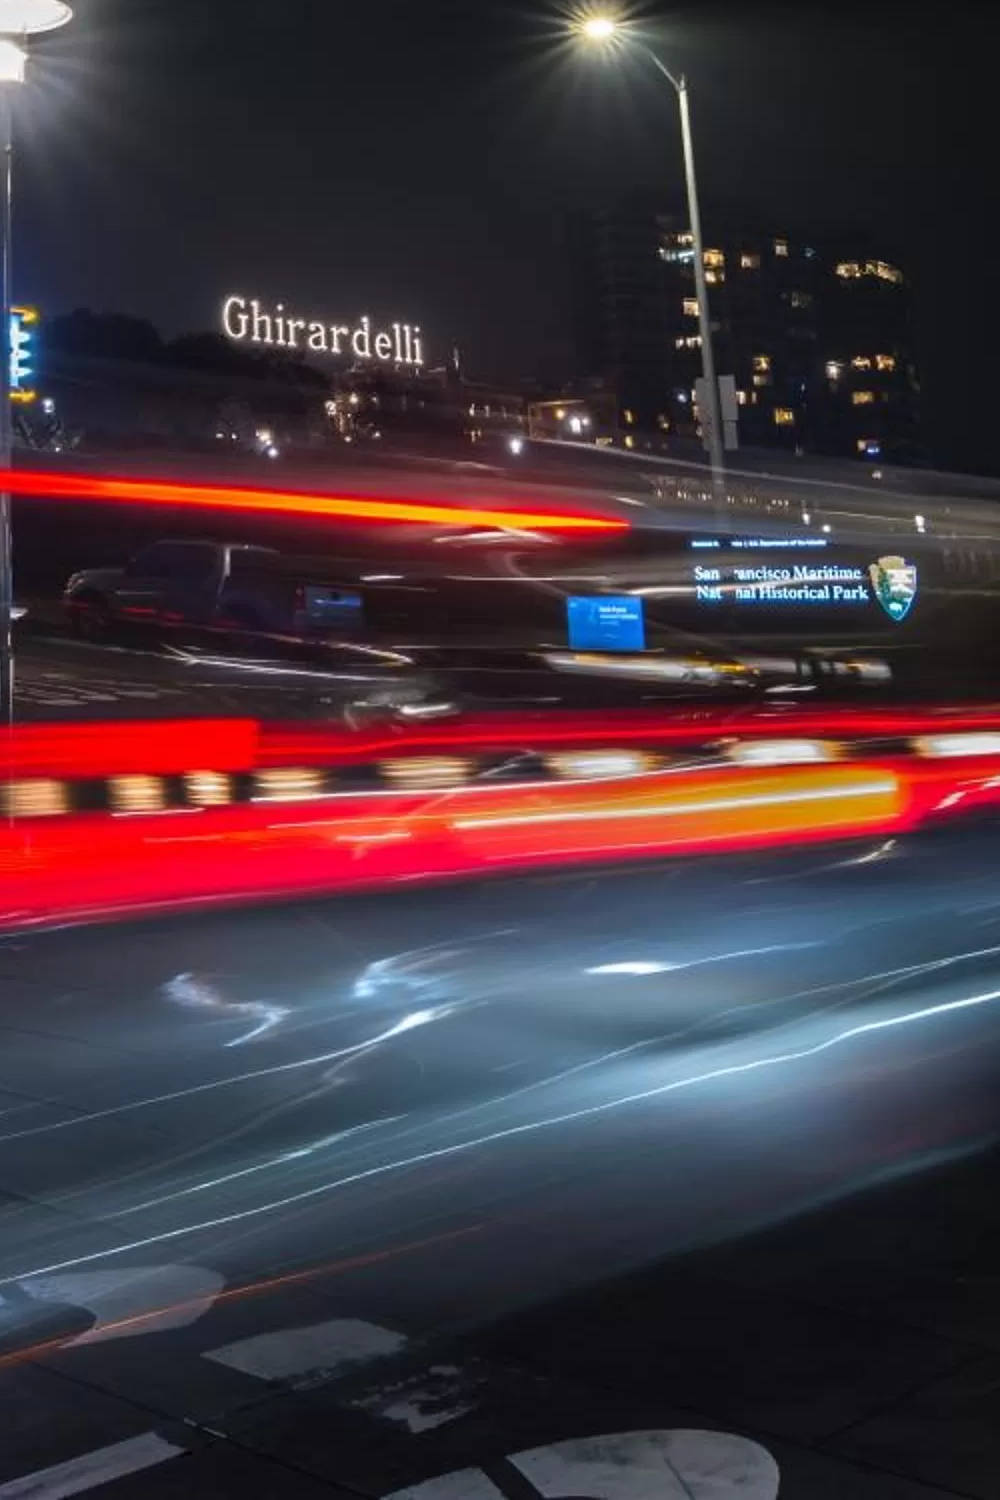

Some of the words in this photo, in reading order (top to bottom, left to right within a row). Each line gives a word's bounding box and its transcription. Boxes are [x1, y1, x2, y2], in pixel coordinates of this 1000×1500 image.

[223, 296, 423, 364] Ghirardelli
[694, 565, 720, 580] San
[793, 565, 862, 580] Maritime
[696, 584, 756, 599] Natnal
[759, 584, 830, 600] Historical
[833, 585, 868, 600] Park
